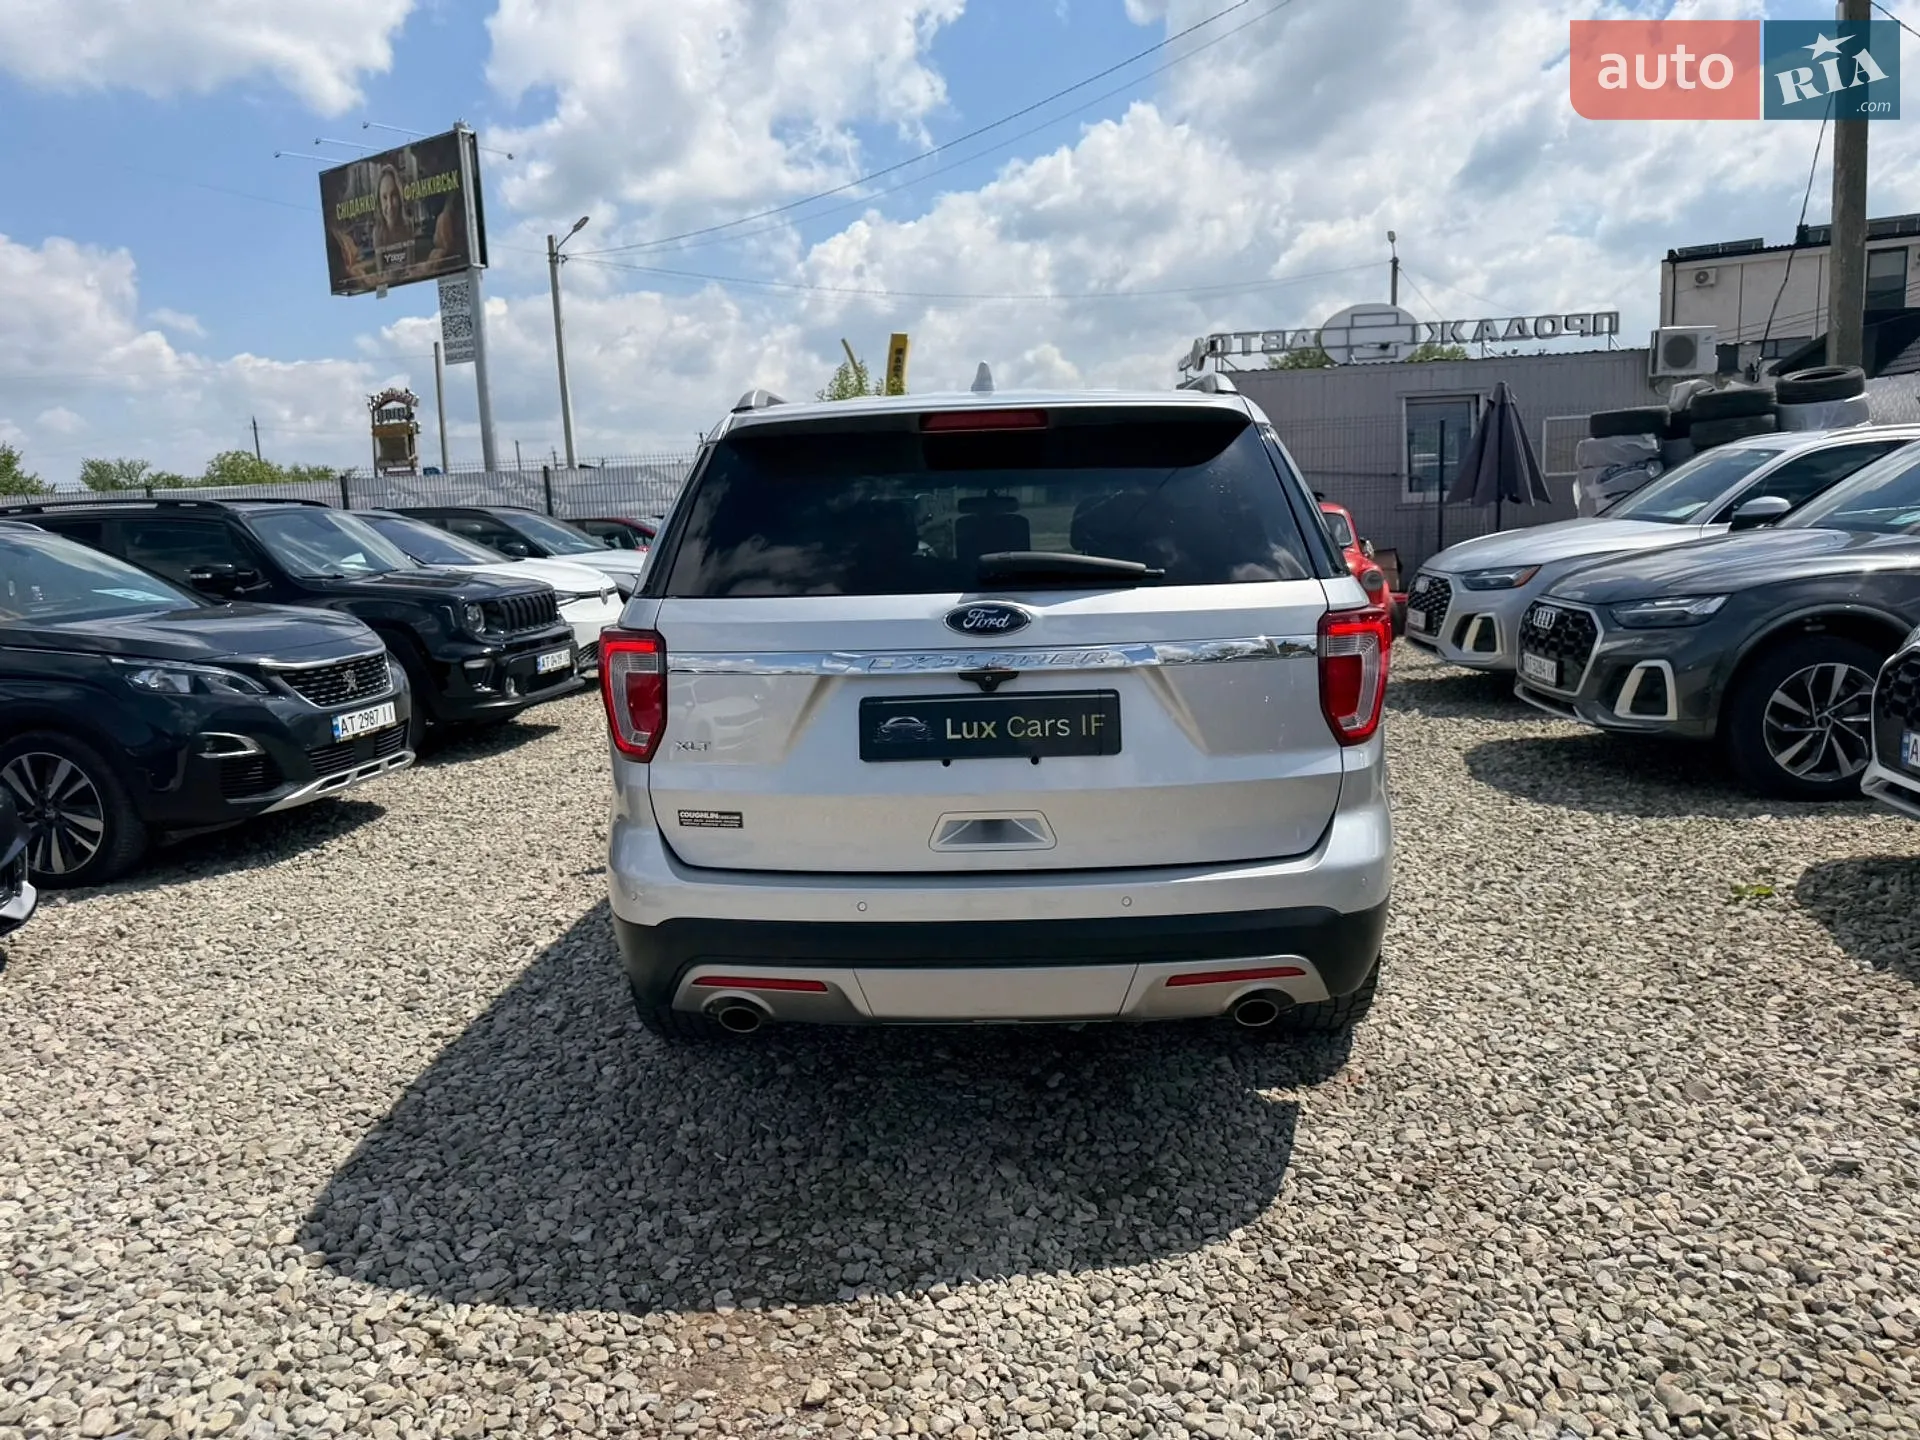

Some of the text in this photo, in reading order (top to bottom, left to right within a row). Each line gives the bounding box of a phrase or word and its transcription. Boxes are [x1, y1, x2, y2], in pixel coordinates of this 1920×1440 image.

[403, 169, 460, 200] ФРАНКІВСЬК
[962, 608, 1011, 631] Ford
[868, 652, 1110, 672] EXPLORER
[341, 715, 356, 734] AT
[358, 709, 379, 729] 2987
[946, 714, 1106, 741] Lux Cars IF
[675, 740, 712, 753] XLT
